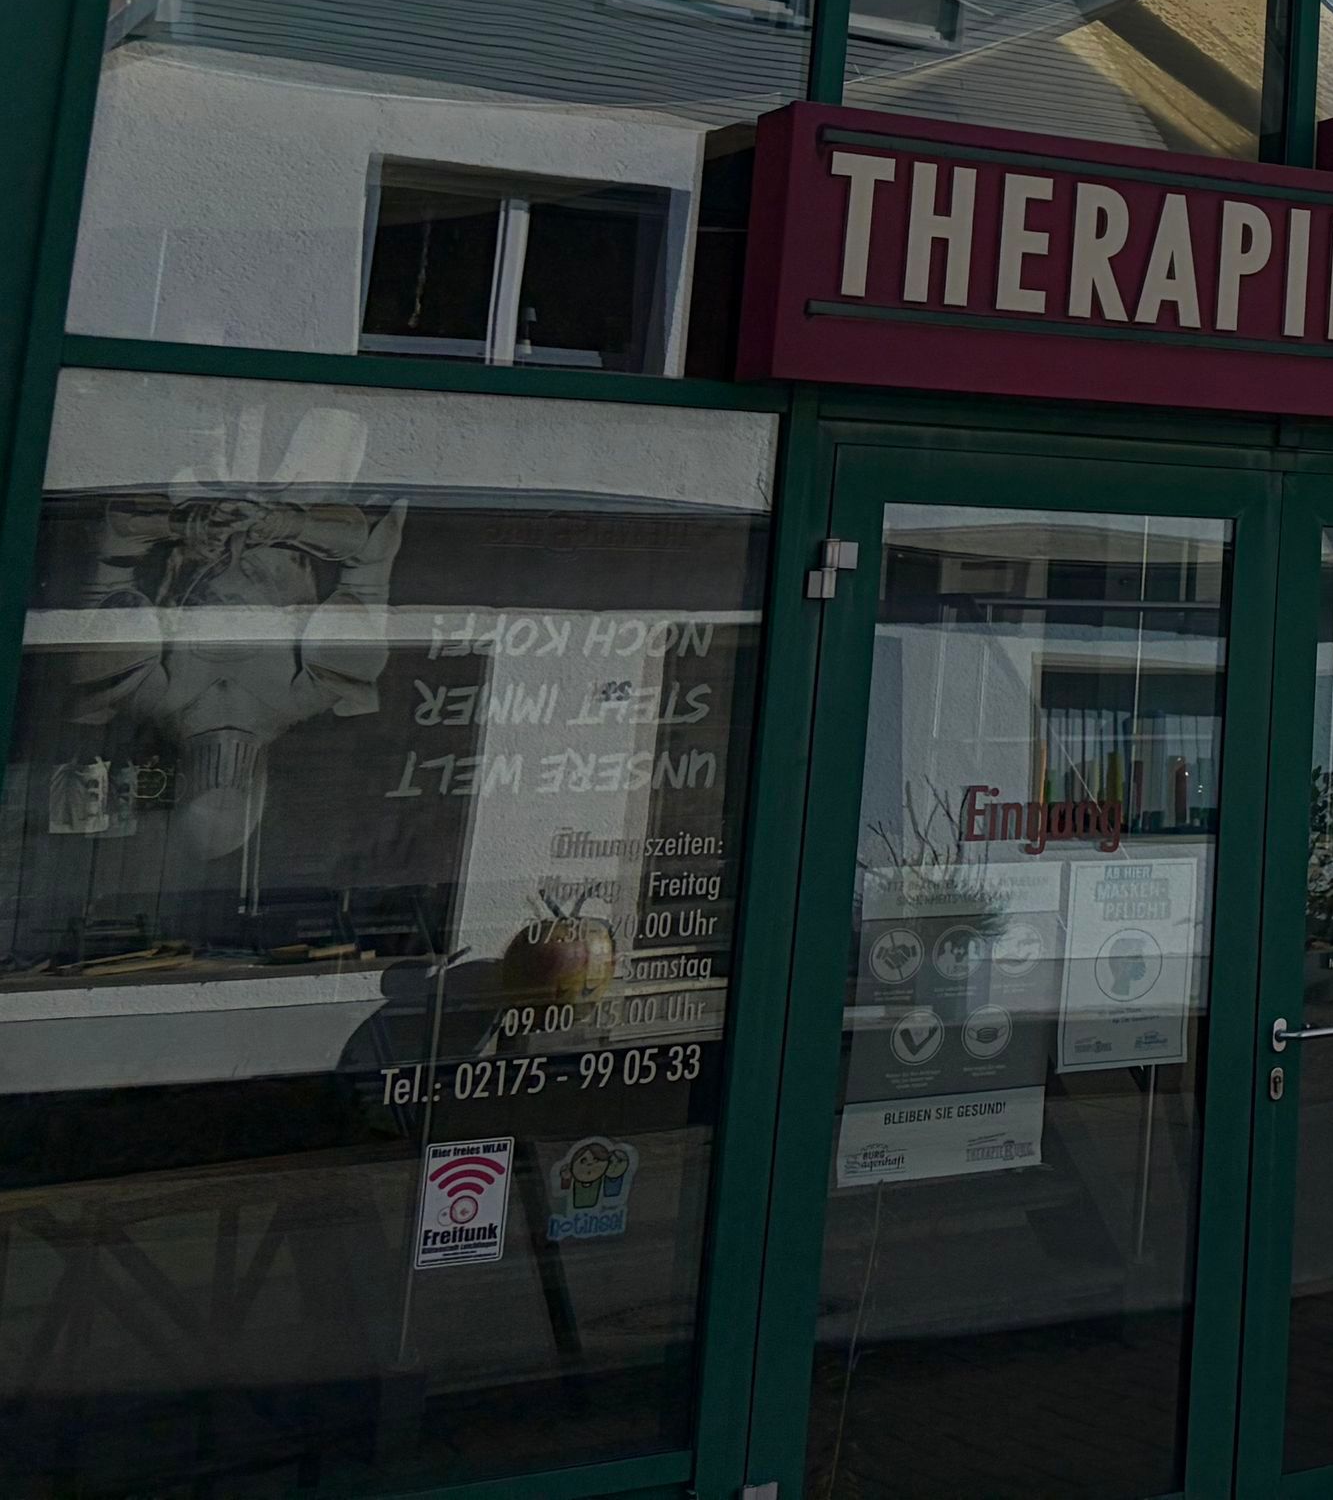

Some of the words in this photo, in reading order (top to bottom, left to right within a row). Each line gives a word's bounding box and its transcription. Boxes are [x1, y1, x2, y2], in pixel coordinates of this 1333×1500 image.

[581, 617, 714, 659] NOCH
[414, 679, 557, 727] IMMER
[385, 749, 523, 799] WELT
[537, 749, 716, 795] UNSERE
[964, 785, 1123, 855] Eingang
[550, 826, 724, 859] Öffnungszeiten:
[648, 870, 722, 902] Freitag
[1124, 866, 1150, 878] HIER
[679, 907, 718, 937] Uhr
[622, 956, 713, 981] Samstag
[504, 1004, 574, 1037] 09.00
[668, 994, 707, 1023] Uhr
[381, 1067, 442, 1106] Tel.:
[454, 1055, 546, 1101] 02175
[578, 1053, 617, 1091] 99
[624, 1049, 659, 1086] 05
[666, 1043, 701, 1080] 33
[884, 1108, 932, 1126] BLEIBEN
[935, 1106, 954, 1120] SIE
[957, 1101, 1006, 1117] GESUND!
[422, 1223, 498, 1246] Freifunk
[549, 1210, 625, 1238] notinsel
